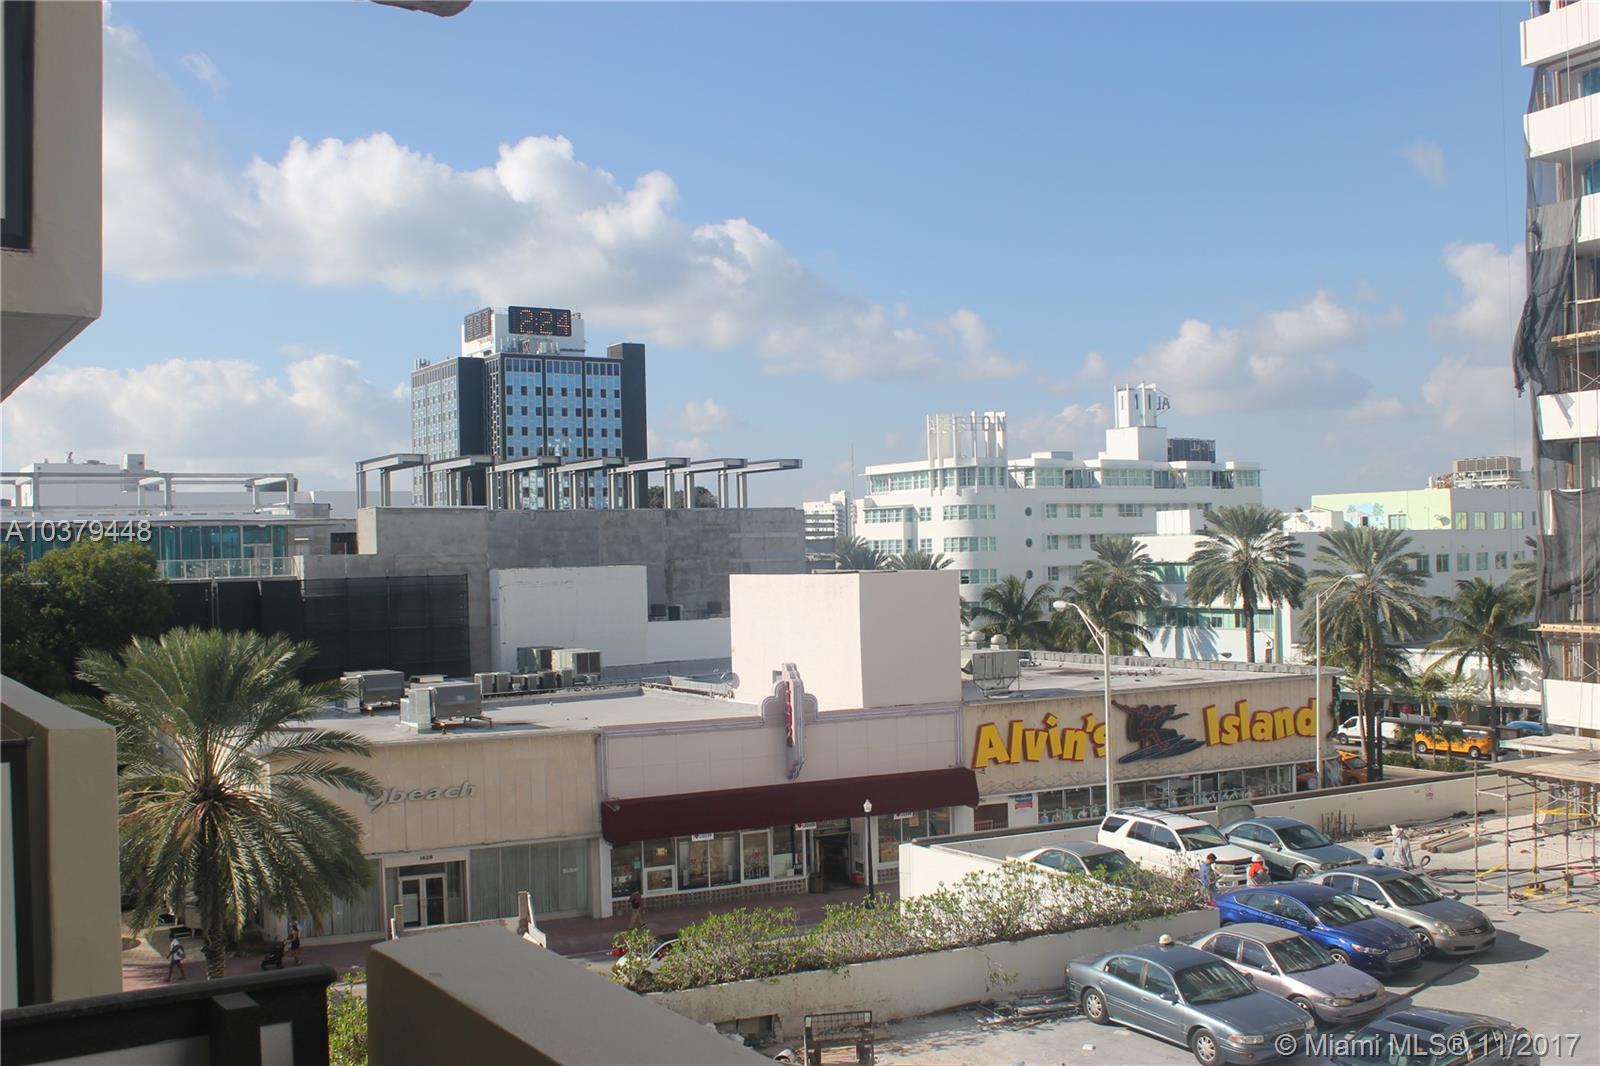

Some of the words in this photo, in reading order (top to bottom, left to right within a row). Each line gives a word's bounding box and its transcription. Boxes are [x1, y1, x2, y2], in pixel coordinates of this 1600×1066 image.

[520, 308, 571, 335] 2:24
[973, 711, 1108, 769] Alvin's
[1203, 698, 1318, 747] Island
